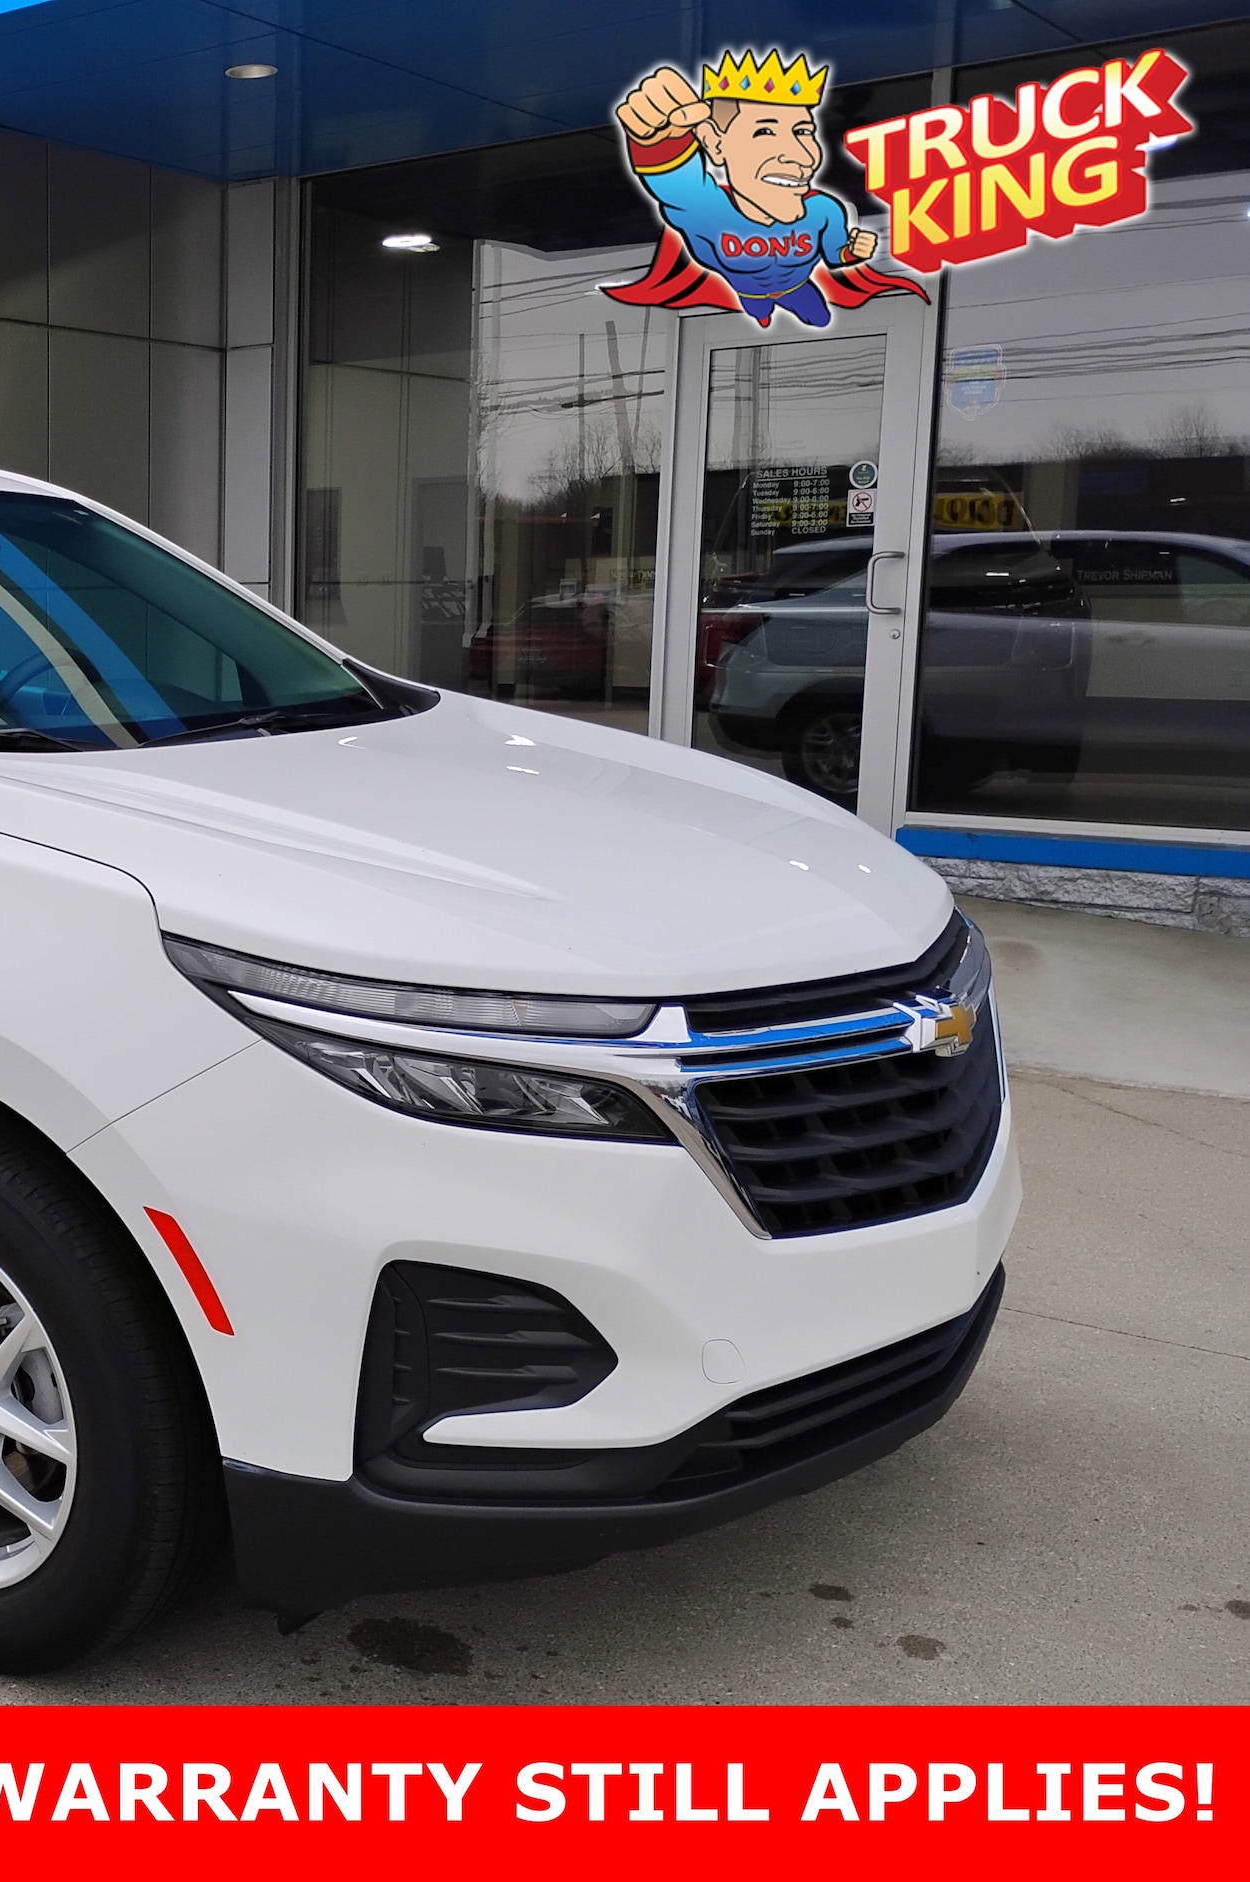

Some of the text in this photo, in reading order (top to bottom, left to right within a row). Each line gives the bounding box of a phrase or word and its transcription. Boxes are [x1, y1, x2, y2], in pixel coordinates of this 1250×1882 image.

[756, 466, 828, 479] SALES HOURS
[793, 479, 830, 487] 9:00-7:00
[793, 487, 830, 495] 9:00-6:00
[752, 497, 791, 505] Wednesday
[752, 505, 782, 513] Thursday
[751, 513, 772, 521] Friday
[751, 526, 827, 537] Sunday CLOSED
[1076, 568, 1173, 581] TREVOR SHIPMAN
